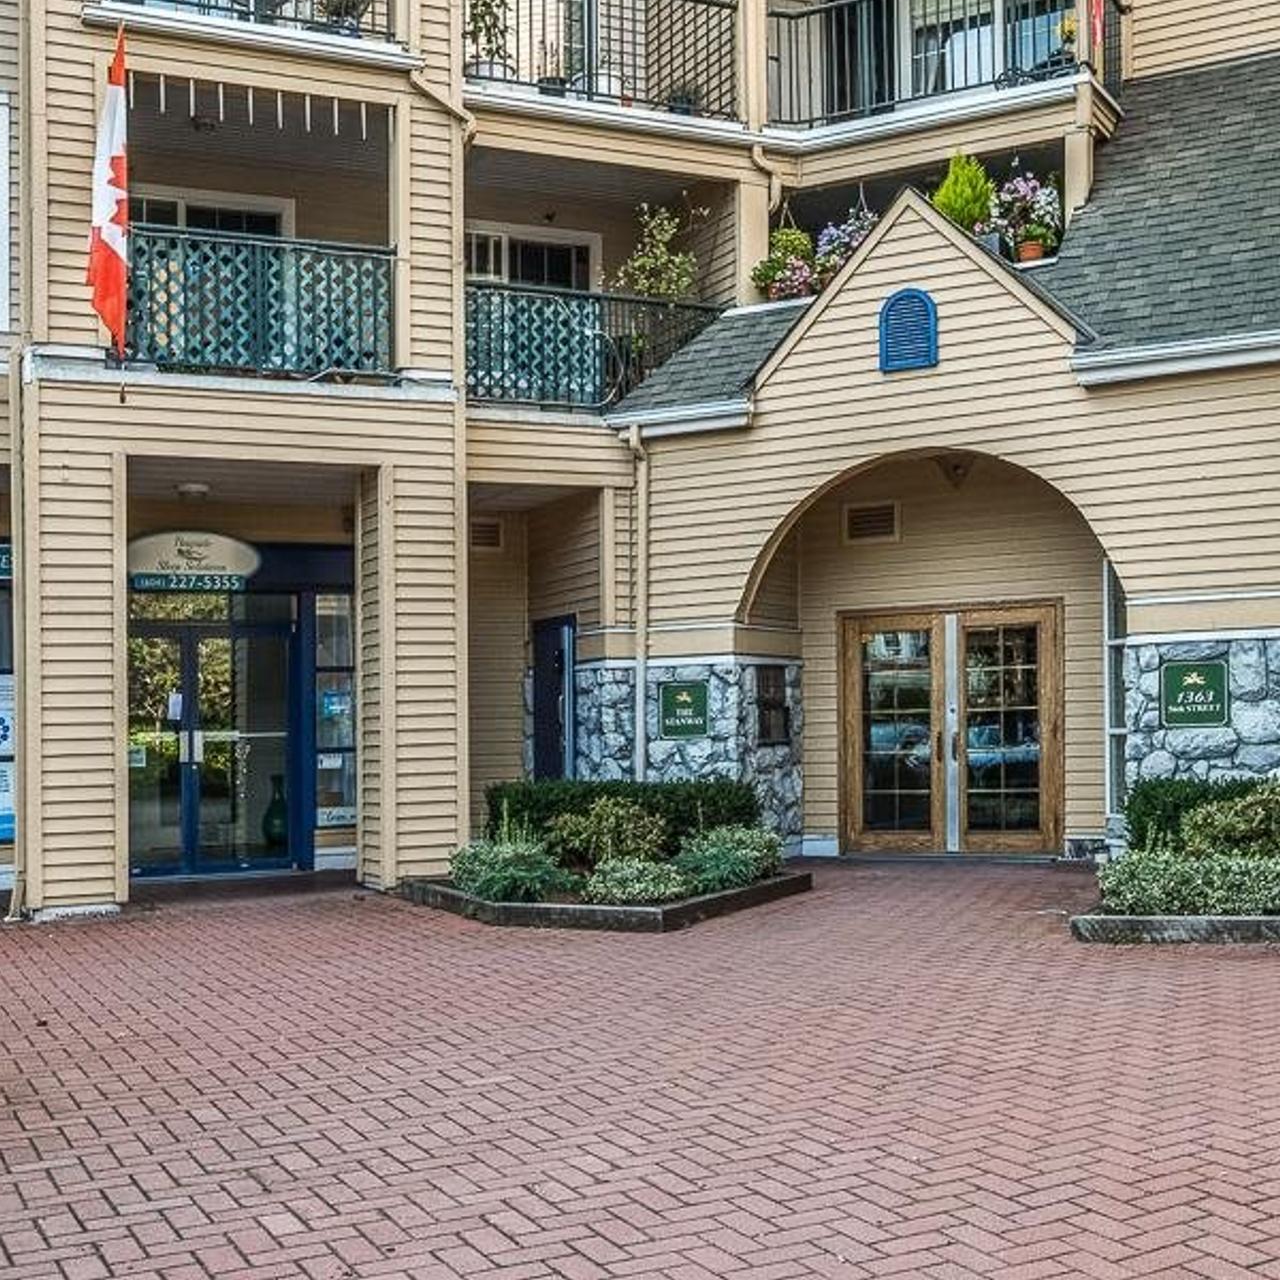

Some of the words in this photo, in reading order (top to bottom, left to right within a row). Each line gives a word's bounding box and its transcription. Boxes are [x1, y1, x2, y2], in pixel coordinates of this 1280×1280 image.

[169, 576, 239, 589] 227-5355
[1177, 690, 1214, 703] 1363
[1186, 703, 1221, 711] STREET
